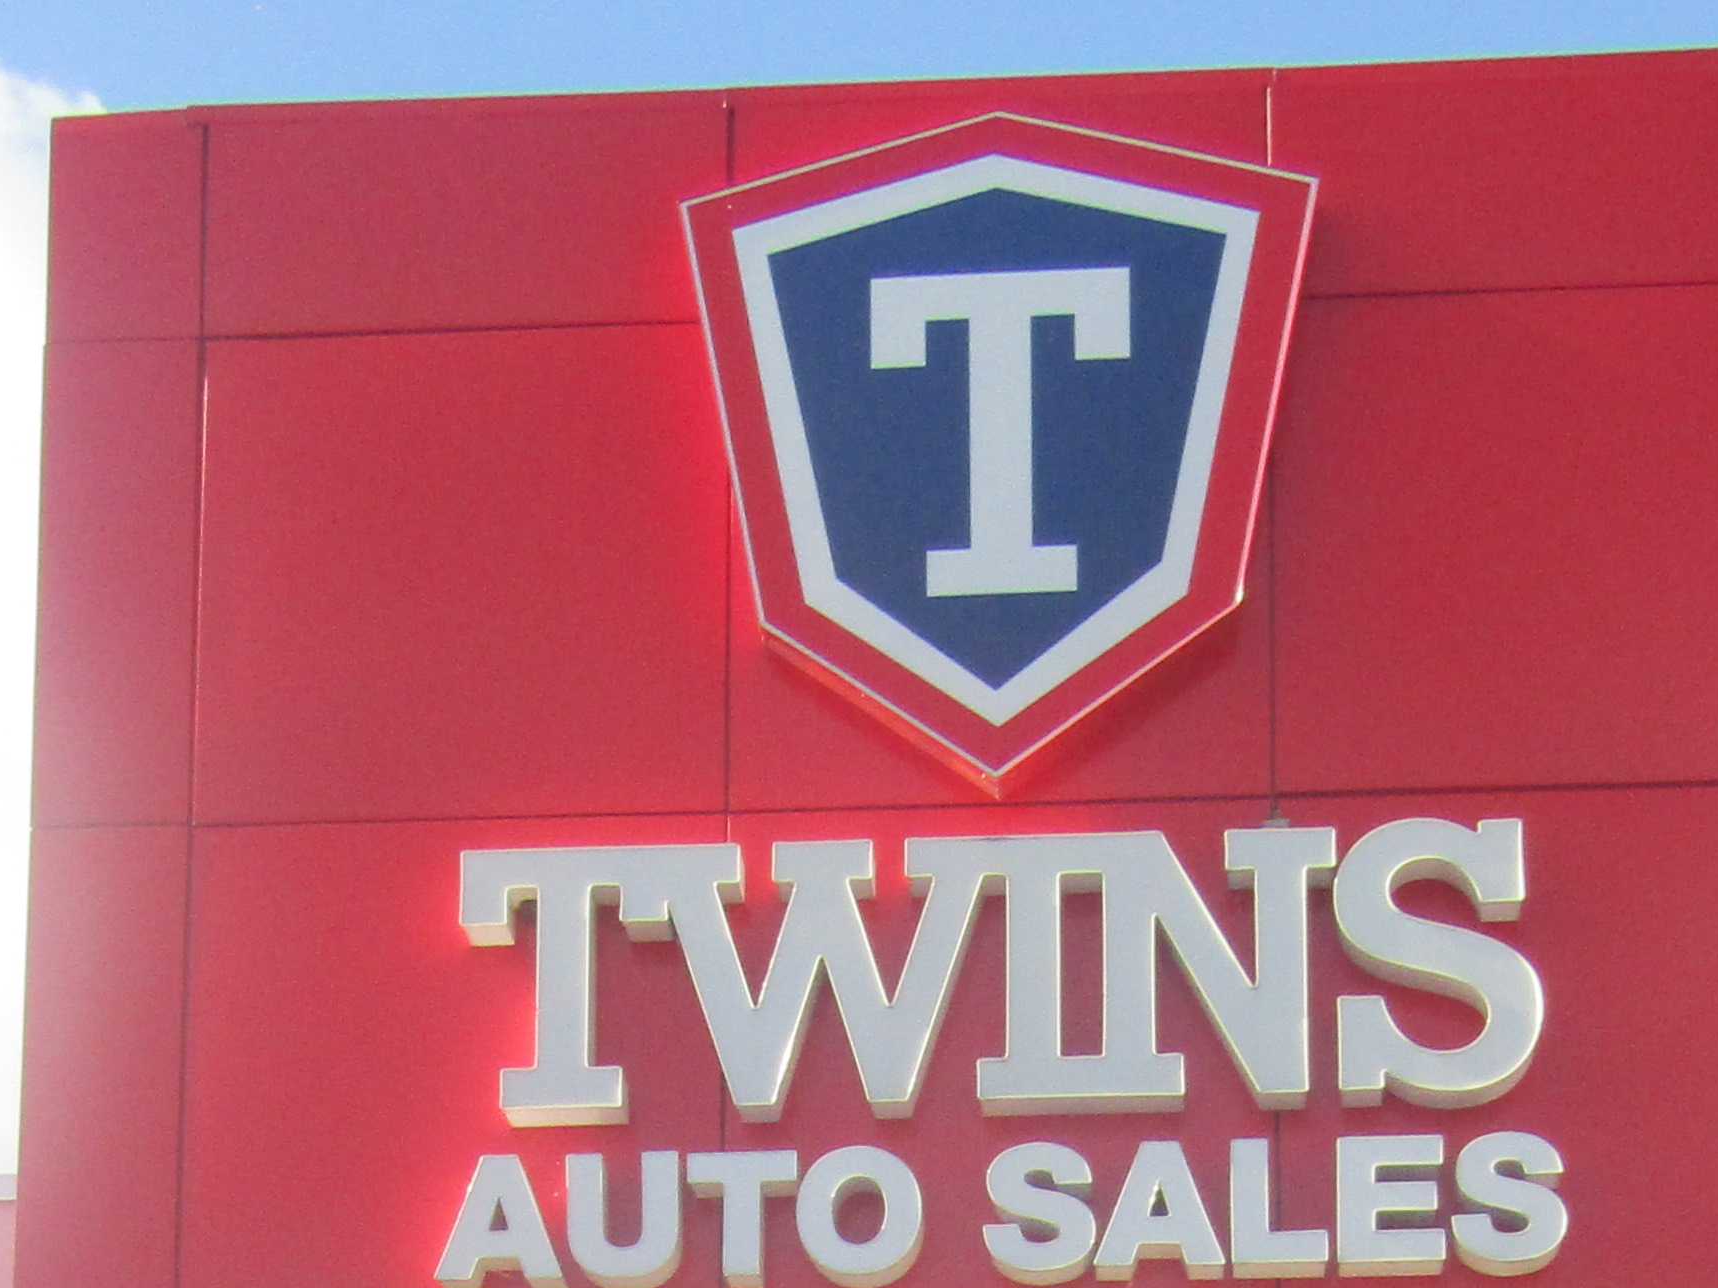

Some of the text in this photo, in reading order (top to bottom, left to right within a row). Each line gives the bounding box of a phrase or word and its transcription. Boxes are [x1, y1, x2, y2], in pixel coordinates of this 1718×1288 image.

[870, 266, 1132, 598] T
[458, 817, 1546, 1127] TWINS
[981, 1131, 1570, 1286] SALES
